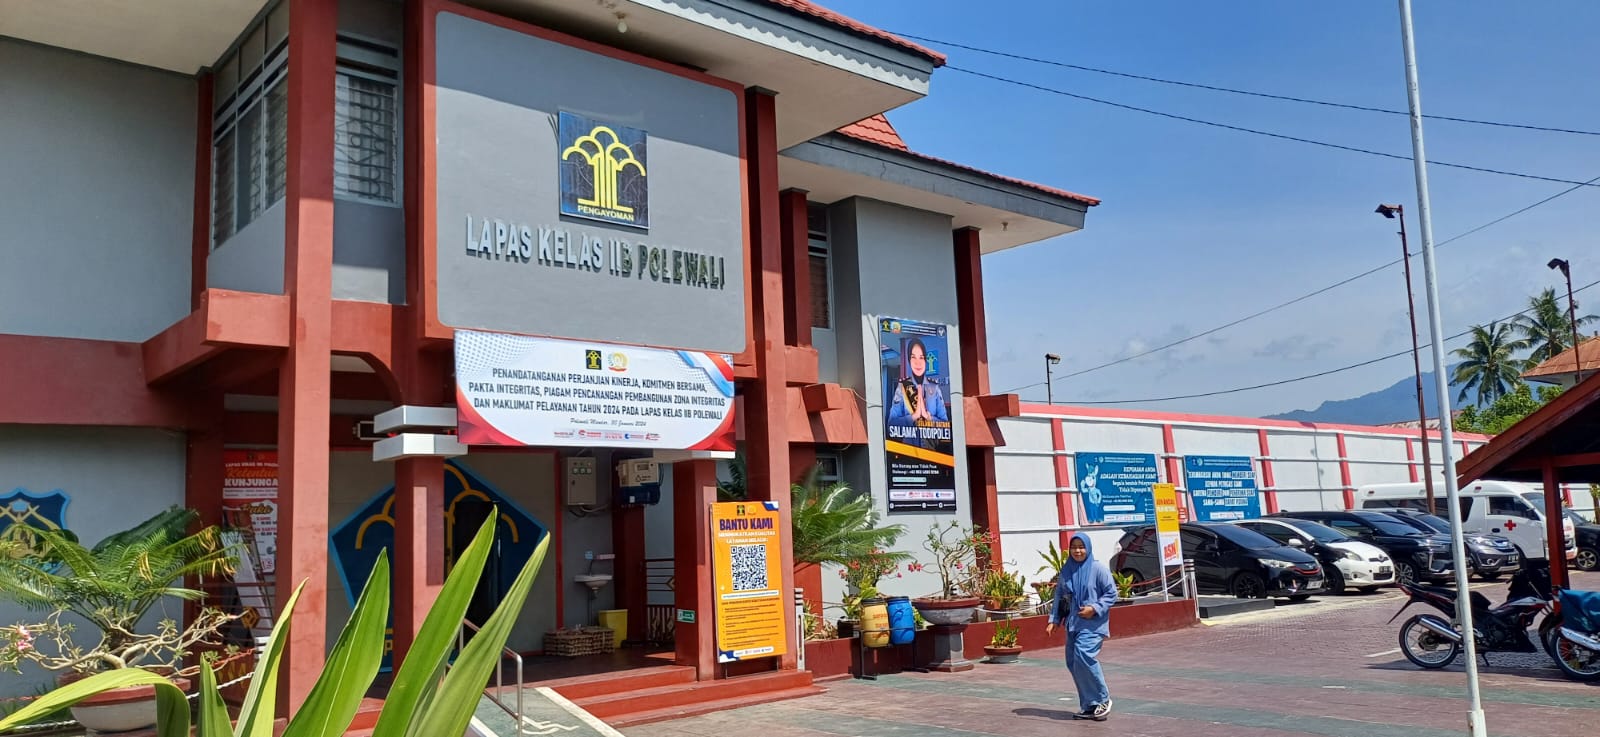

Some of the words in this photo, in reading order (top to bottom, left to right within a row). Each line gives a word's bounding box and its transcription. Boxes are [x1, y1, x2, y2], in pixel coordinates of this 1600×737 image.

[578, 205, 634, 222] PENGAYOMAN
[466, 214, 531, 262] LAPAS
[538, 224, 603, 271] KELAS
[609, 236, 633, 277] IIB
[638, 242, 725, 289] POLEWALI
[492, 368, 566, 383] PENANDATANGANAN
[568, 373, 610, 387] PERJANJIAN
[611, 376, 641, 389] KINERJA,
[642, 379, 675, 391] KOMITMEN
[677, 381, 708, 393] BERSAMA,
[469, 382, 495, 393] PAKTA
[496, 383, 543, 398] INTEGRITAS,
[544, 386, 572, 398] PIAGAM
[573, 388, 624, 401] PENCANANGAN
[625, 391, 673, 404] PEMBANGUNAN
[674, 394, 690, 405] ZONA
[691, 395, 725, 407] INTEGRITAS
[474, 397, 491, 409] DAN
[492, 398, 535, 411] MAKLUMAT
[536, 400, 578, 413] PELAYANAN
[580, 403, 602, 414] TAHUN
[603, 404, 620, 415] 2024
[622, 405, 639, 416] PADA
[641, 407, 662, 417] LAPAS
[663, 408, 683, 418] KELAS
[693, 409, 723, 420] POLEWALI
[224, 478, 278, 487] KUNJUNGA
[719, 518, 748, 531] BANTU
[750, 517, 773, 530] KAMI
